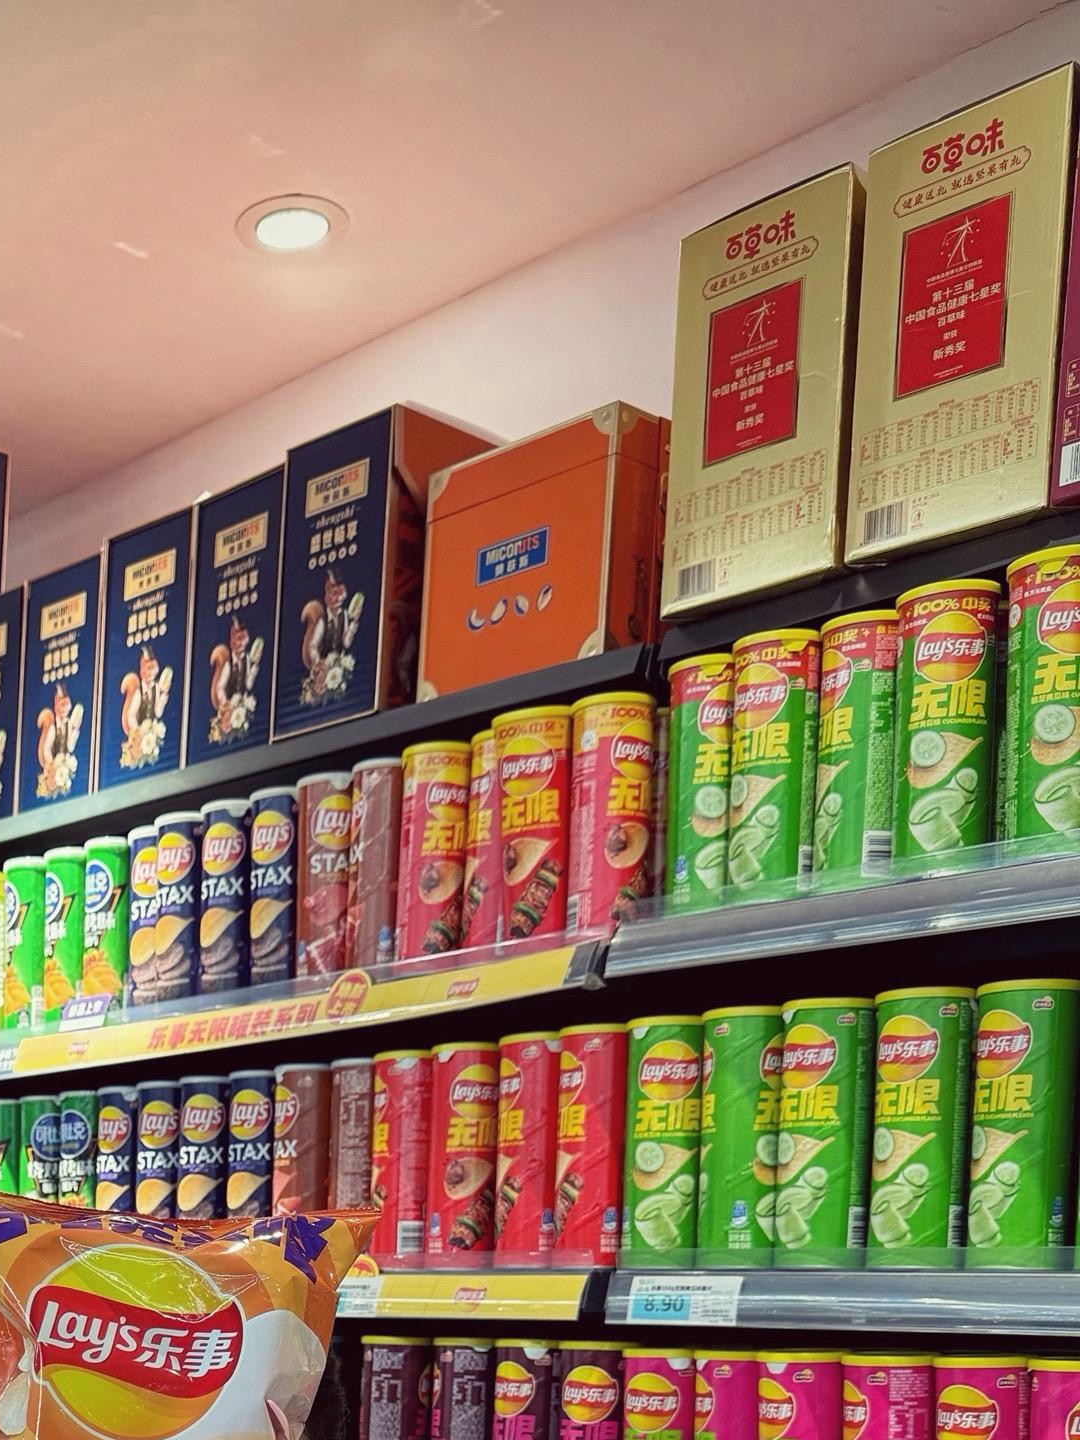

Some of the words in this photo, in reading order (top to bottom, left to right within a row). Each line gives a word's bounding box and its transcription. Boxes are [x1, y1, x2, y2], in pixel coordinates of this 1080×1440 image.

[920, 117, 1005, 175] 百草味
[901, 185, 948, 210] 健康送礼
[951, 154, 1022, 191] 就选坚果有礼
[725, 209, 797, 261] 百草味
[904, 282, 1002, 325] 中国食品健康七星奖
[931, 278, 975, 304] 第十三届
[938, 309, 967, 328] 百草味
[933, 340, 967, 361] 新秀奖
[712, 359, 795, 399] 中国食品健康七星奖
[735, 356, 772, 380] 第十三届
[917, 637, 985, 662] Lay's乐事
[910, 679, 987, 723] 无限
[819, 706, 854, 747] 限
[501, 789, 560, 829] 无限
[251, 818, 290, 848] Lay's
[203, 832, 246, 863] Lay's
[201, 876, 245, 900] STAX
[251, 865, 293, 890] STAX
[147, 1000, 321, 1049] 乐事无限罐装系列
[878, 1034, 937, 1062] Lay's乐事
[875, 1078, 941, 1117] 无限
[140, 1112, 179, 1139] Lay's
[184, 1105, 223, 1132] Lay's
[231, 1101, 268, 1127] Lay's
[634, 1098, 700, 1132] 无限
[137, 1150, 182, 1172] STAX
[179, 1144, 224, 1166] STAX
[228, 1141, 271, 1163] STAX
[643, 1294, 685, 1313] 8.90
[36, 1298, 240, 1380] Lay's乐事
[563, 1385, 617, 1405] Lay's乐事
[625, 1393, 678, 1413] Lay's乐事
[937, 1408, 996, 1431] Lay's乐事
